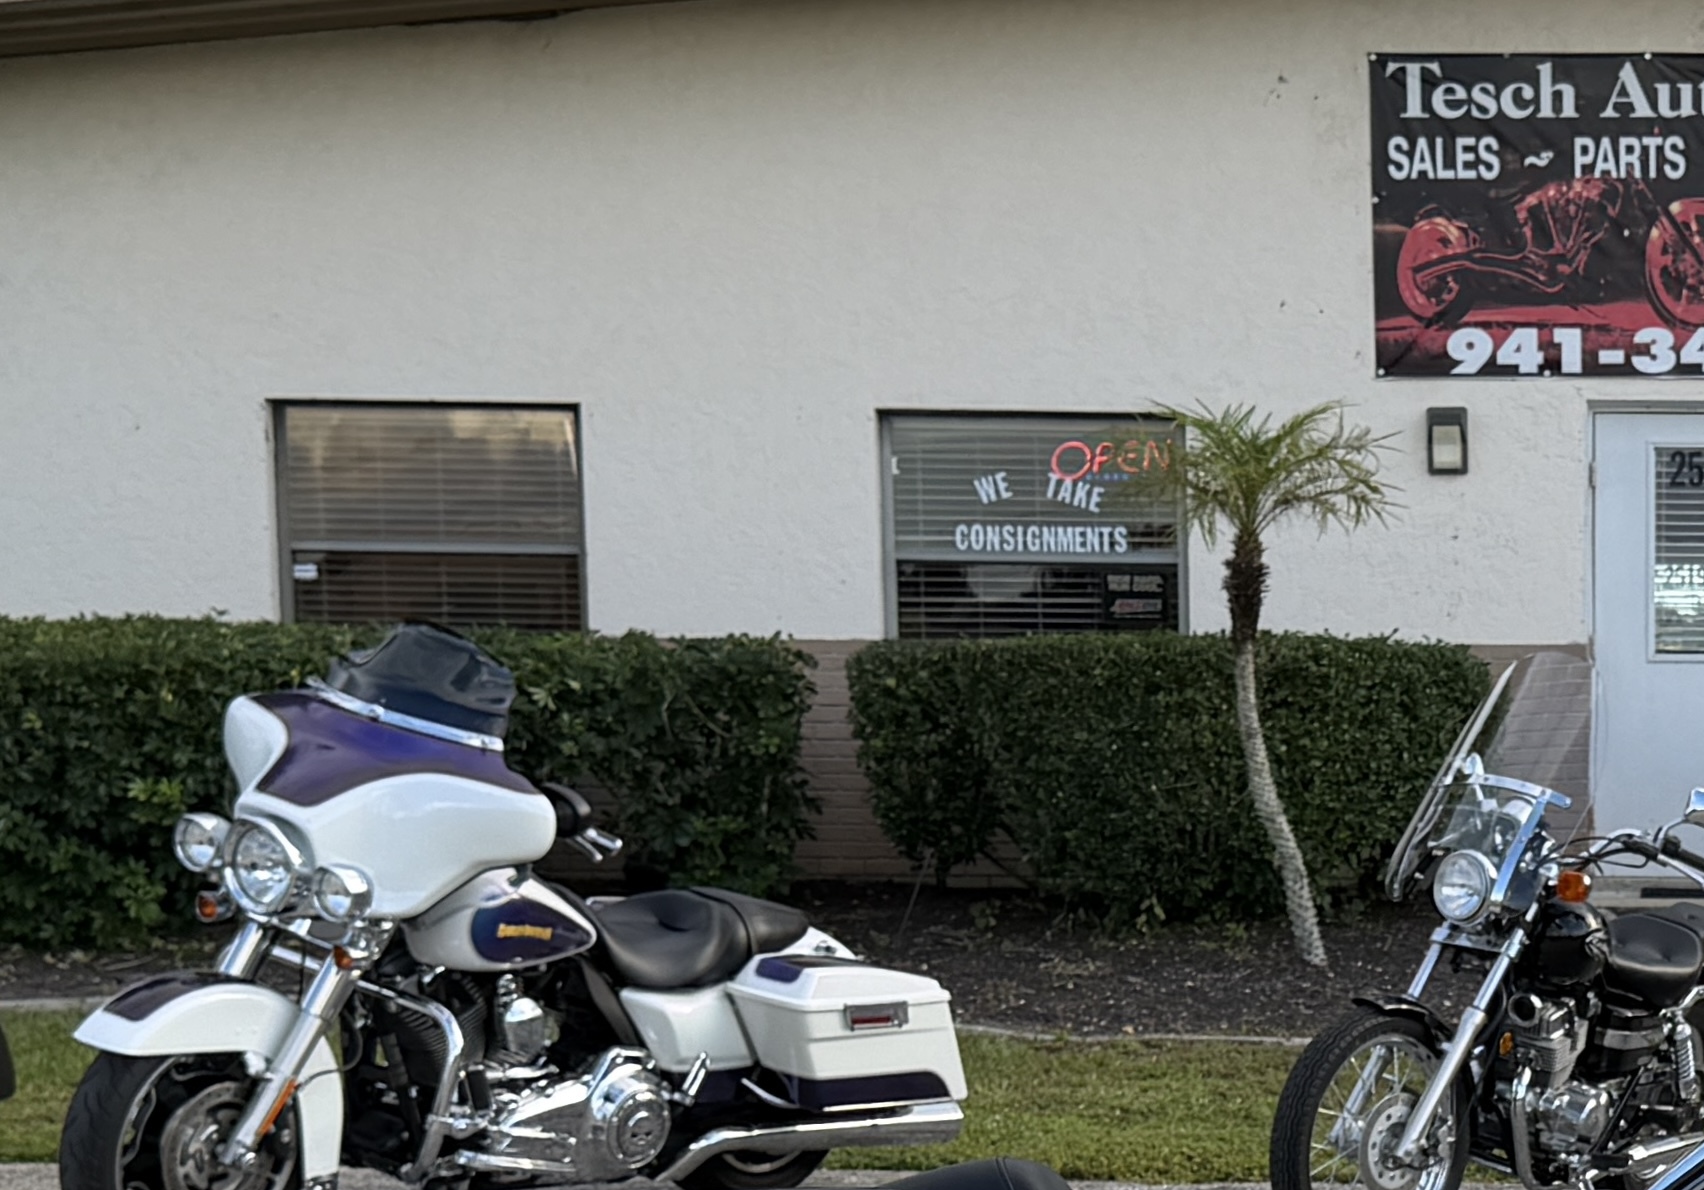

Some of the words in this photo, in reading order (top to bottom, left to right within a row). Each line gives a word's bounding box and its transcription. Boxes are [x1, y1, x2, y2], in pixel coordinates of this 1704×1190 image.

[1385, 61, 1580, 119] Tesch
[1387, 135, 1501, 180] SALES
[1573, 135, 1686, 180] PARTS
[1051, 439, 1172, 480] OPEN
[973, 471, 1013, 505] WE
[1046, 473, 1105, 513] TAKE
[954, 524, 1127, 553] CONSIGNMENTS
